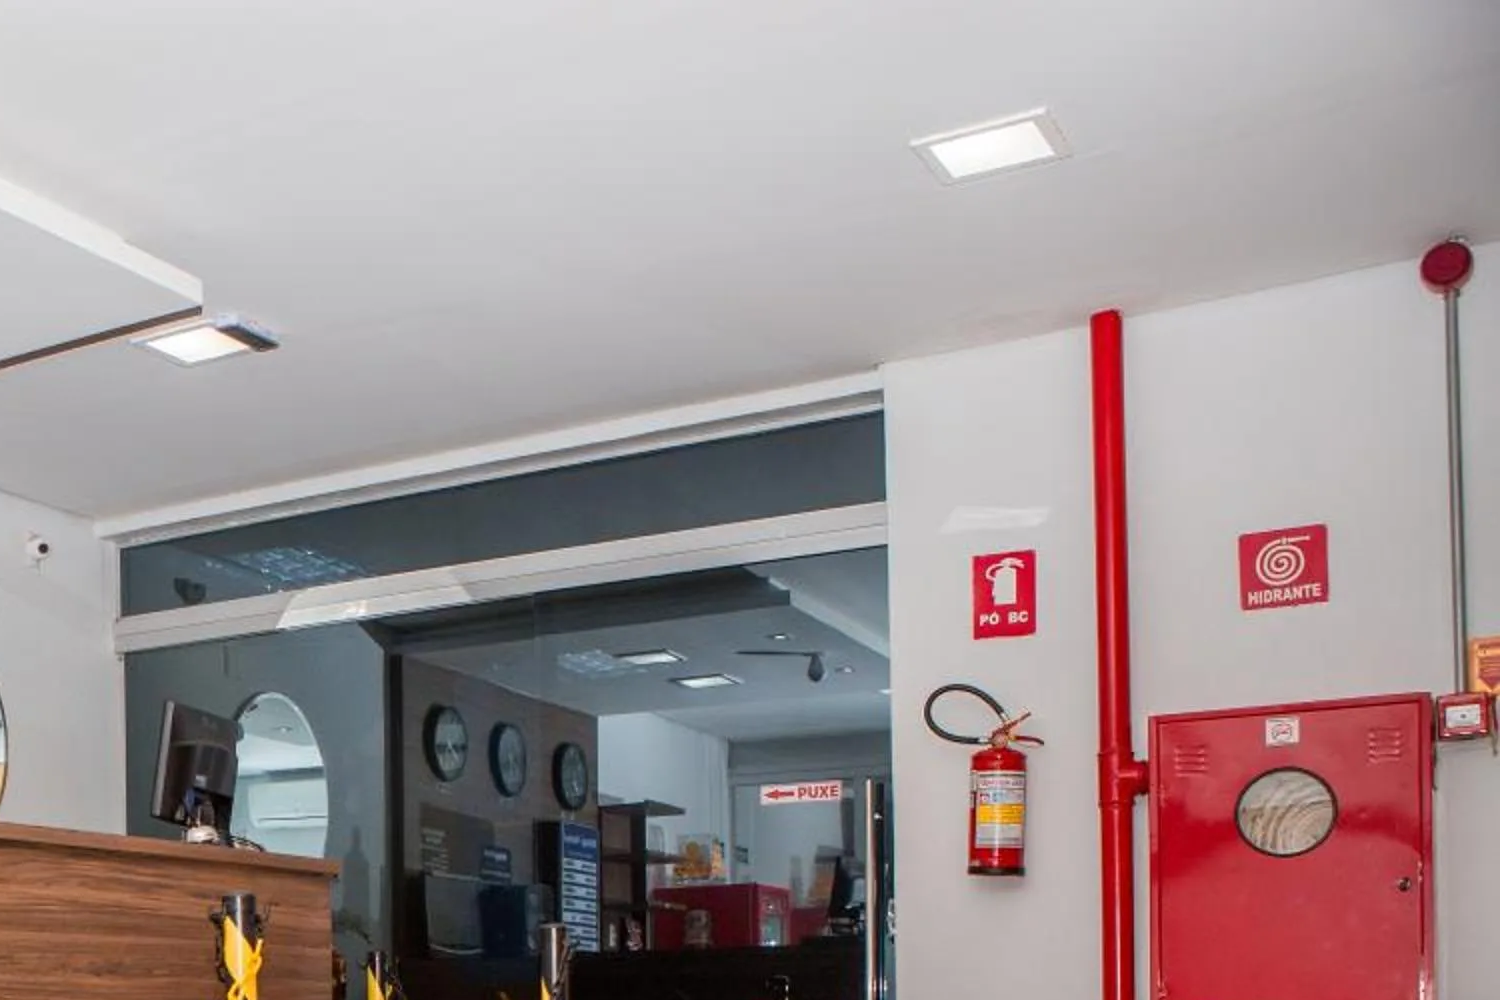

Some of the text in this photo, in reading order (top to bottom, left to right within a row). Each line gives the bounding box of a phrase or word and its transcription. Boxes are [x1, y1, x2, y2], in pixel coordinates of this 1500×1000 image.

[1247, 583, 1322, 606] HIDRANTE
[980, 611, 1029, 626] PÓ BC
[797, 785, 839, 799] PUXE
